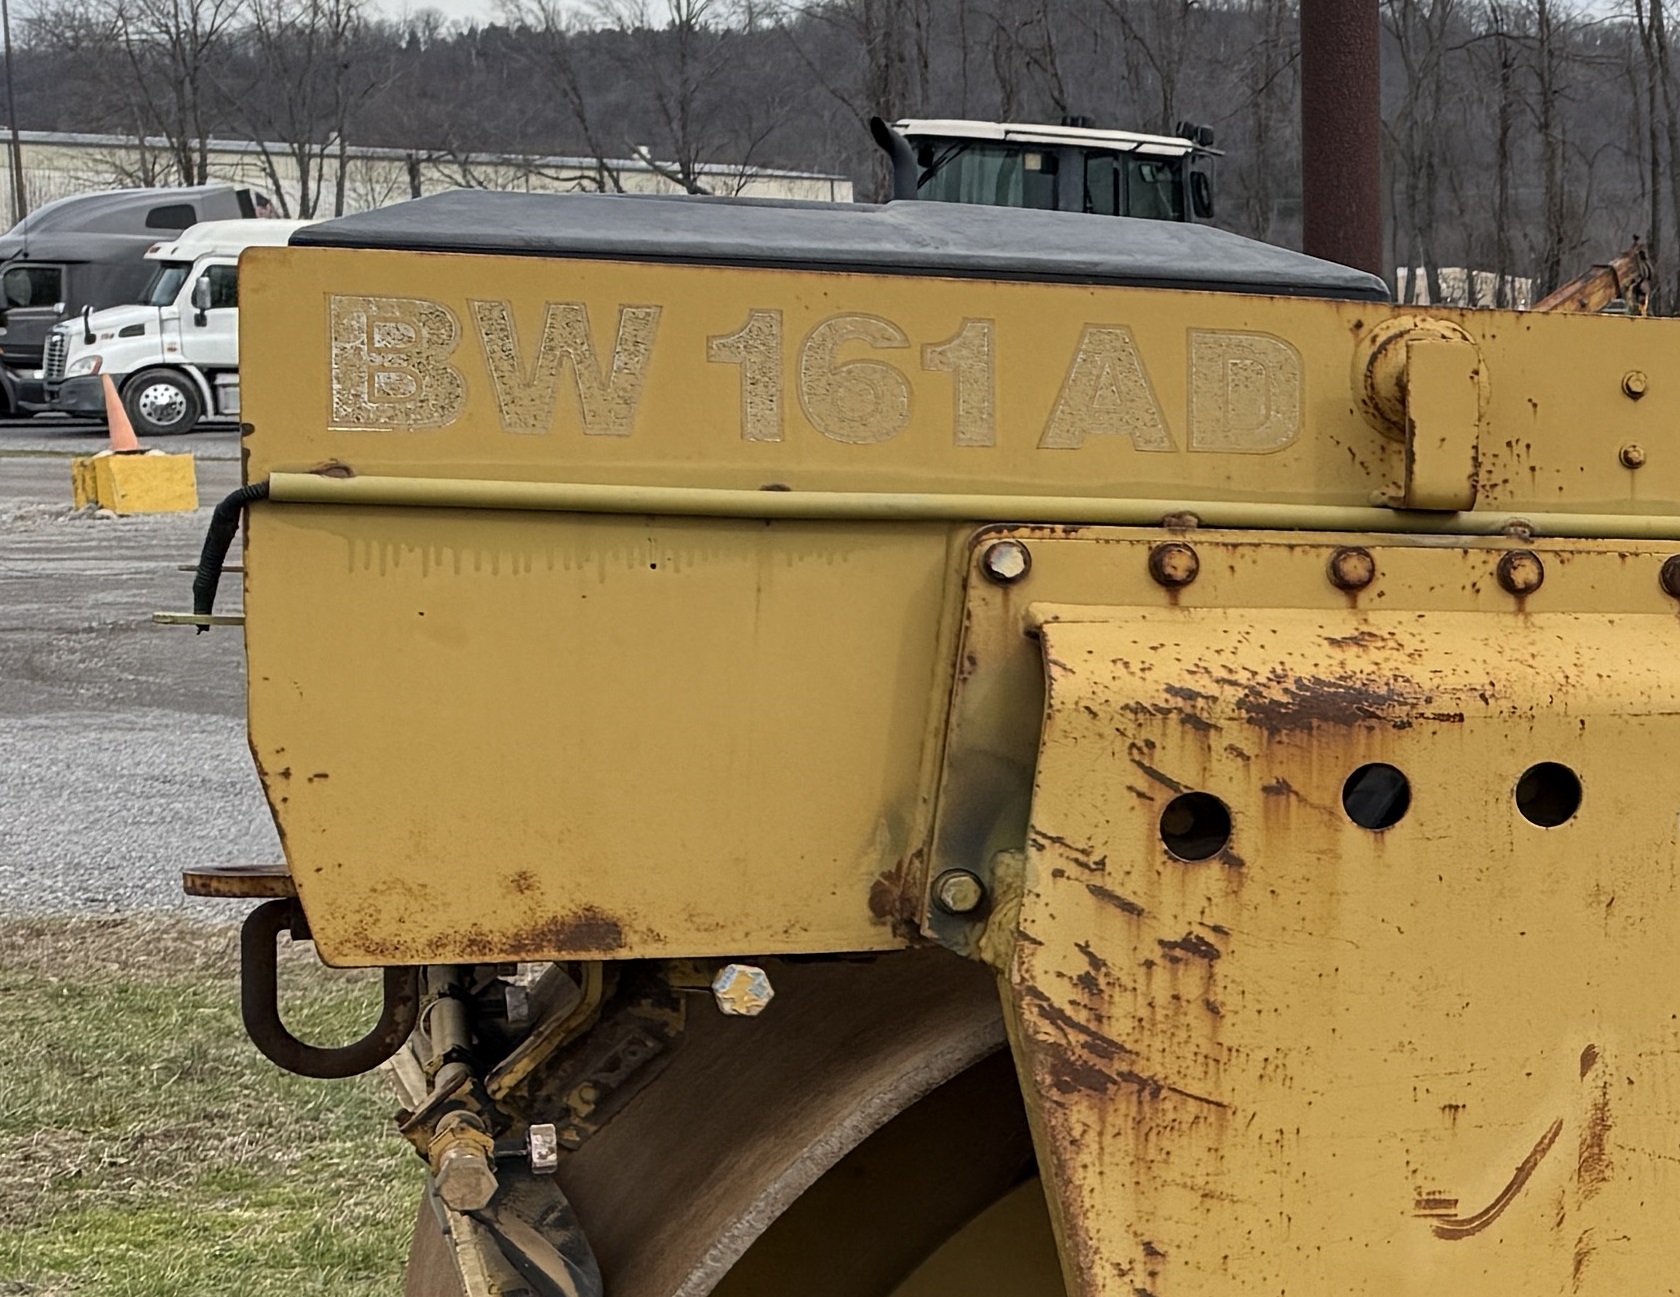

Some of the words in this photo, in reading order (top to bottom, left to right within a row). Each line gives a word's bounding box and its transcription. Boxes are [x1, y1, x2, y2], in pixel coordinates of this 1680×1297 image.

[327, 292, 663, 438] BW
[705, 306, 997, 447] 161
[1036, 323, 1307, 455] AD
